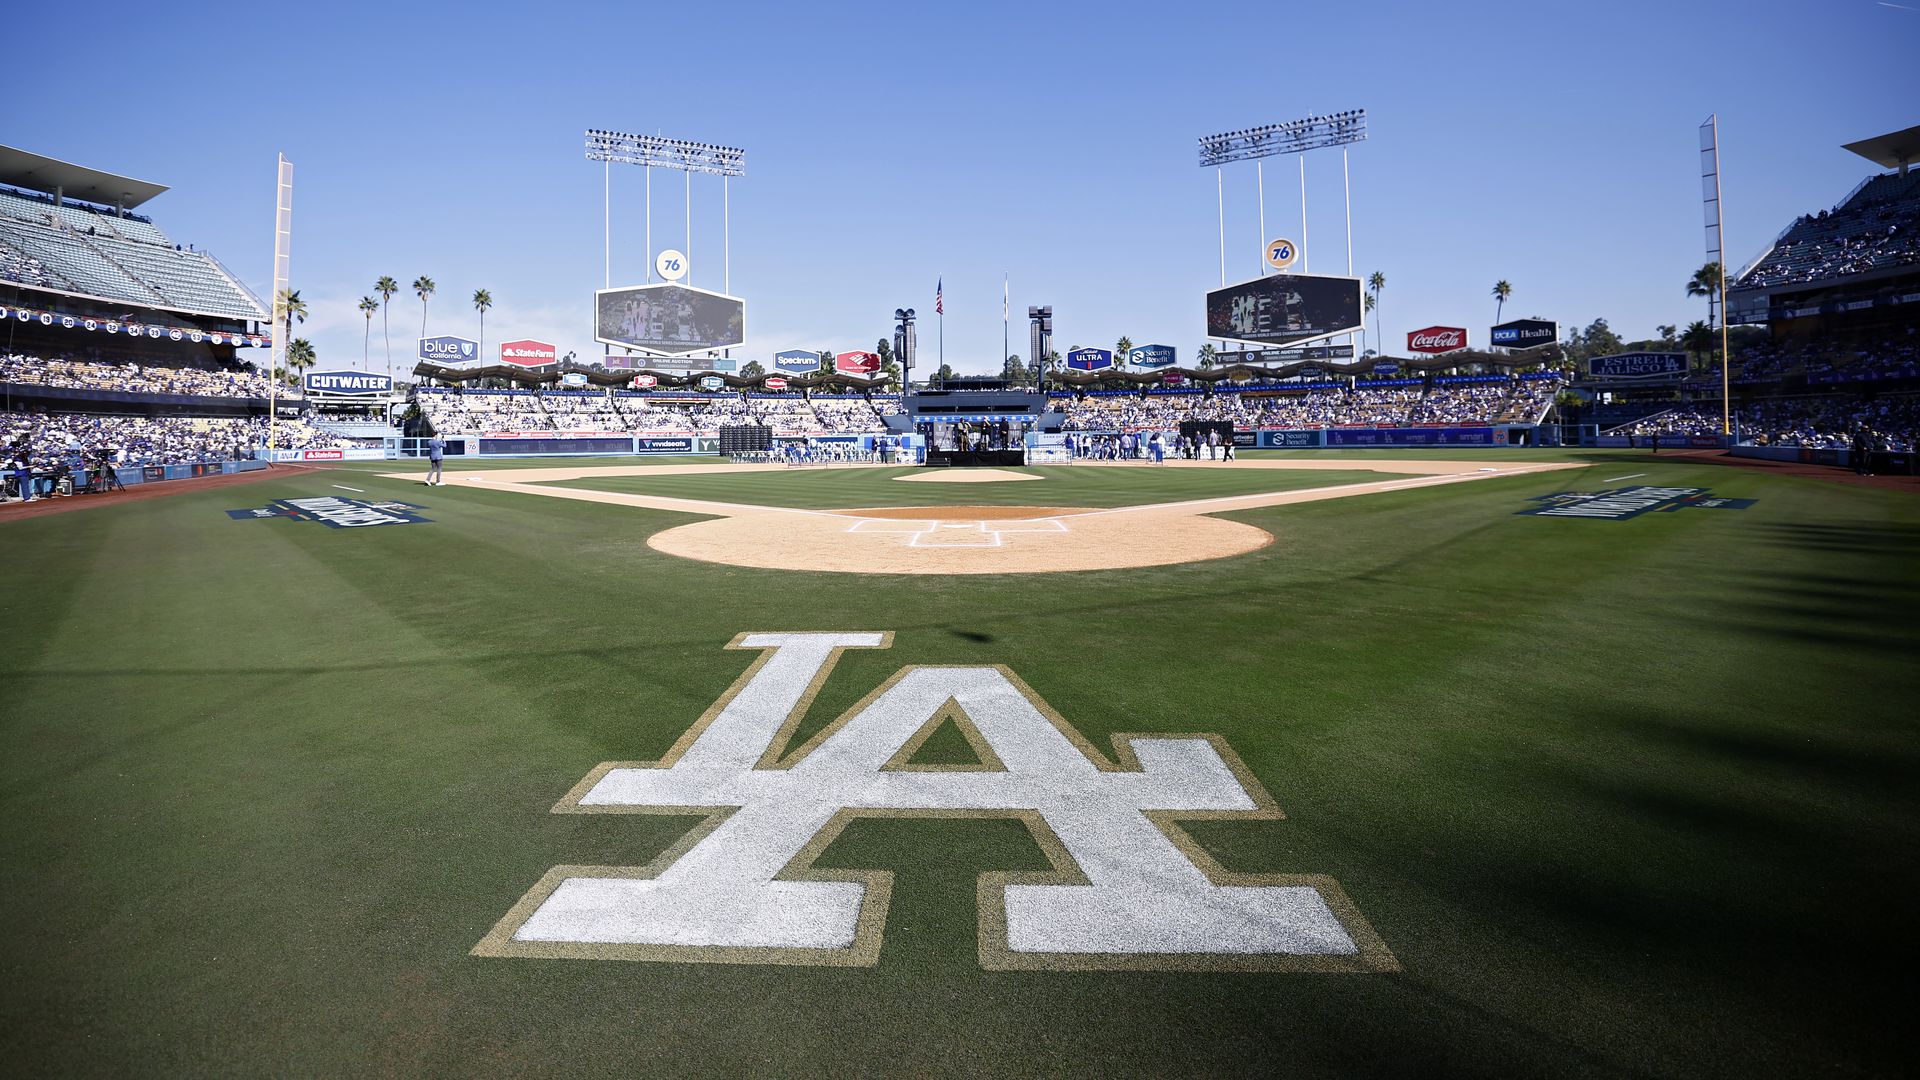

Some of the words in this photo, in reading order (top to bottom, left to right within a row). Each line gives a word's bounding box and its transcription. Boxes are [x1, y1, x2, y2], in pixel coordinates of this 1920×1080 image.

[1272, 246, 1290, 260] 76
[664, 259, 680, 271] 76
[1412, 331, 1462, 348] Coca-Cola
[1494, 331, 1516, 339] UCLA
[1521, 328, 1552, 338] Health
[424, 340, 458, 353] blue
[778, 356, 814, 366] Spectrum
[1598, 364, 1660, 374] JALISCO
[311, 376, 386, 389] CUTWATER
[469, 631, 1401, 973] LA
